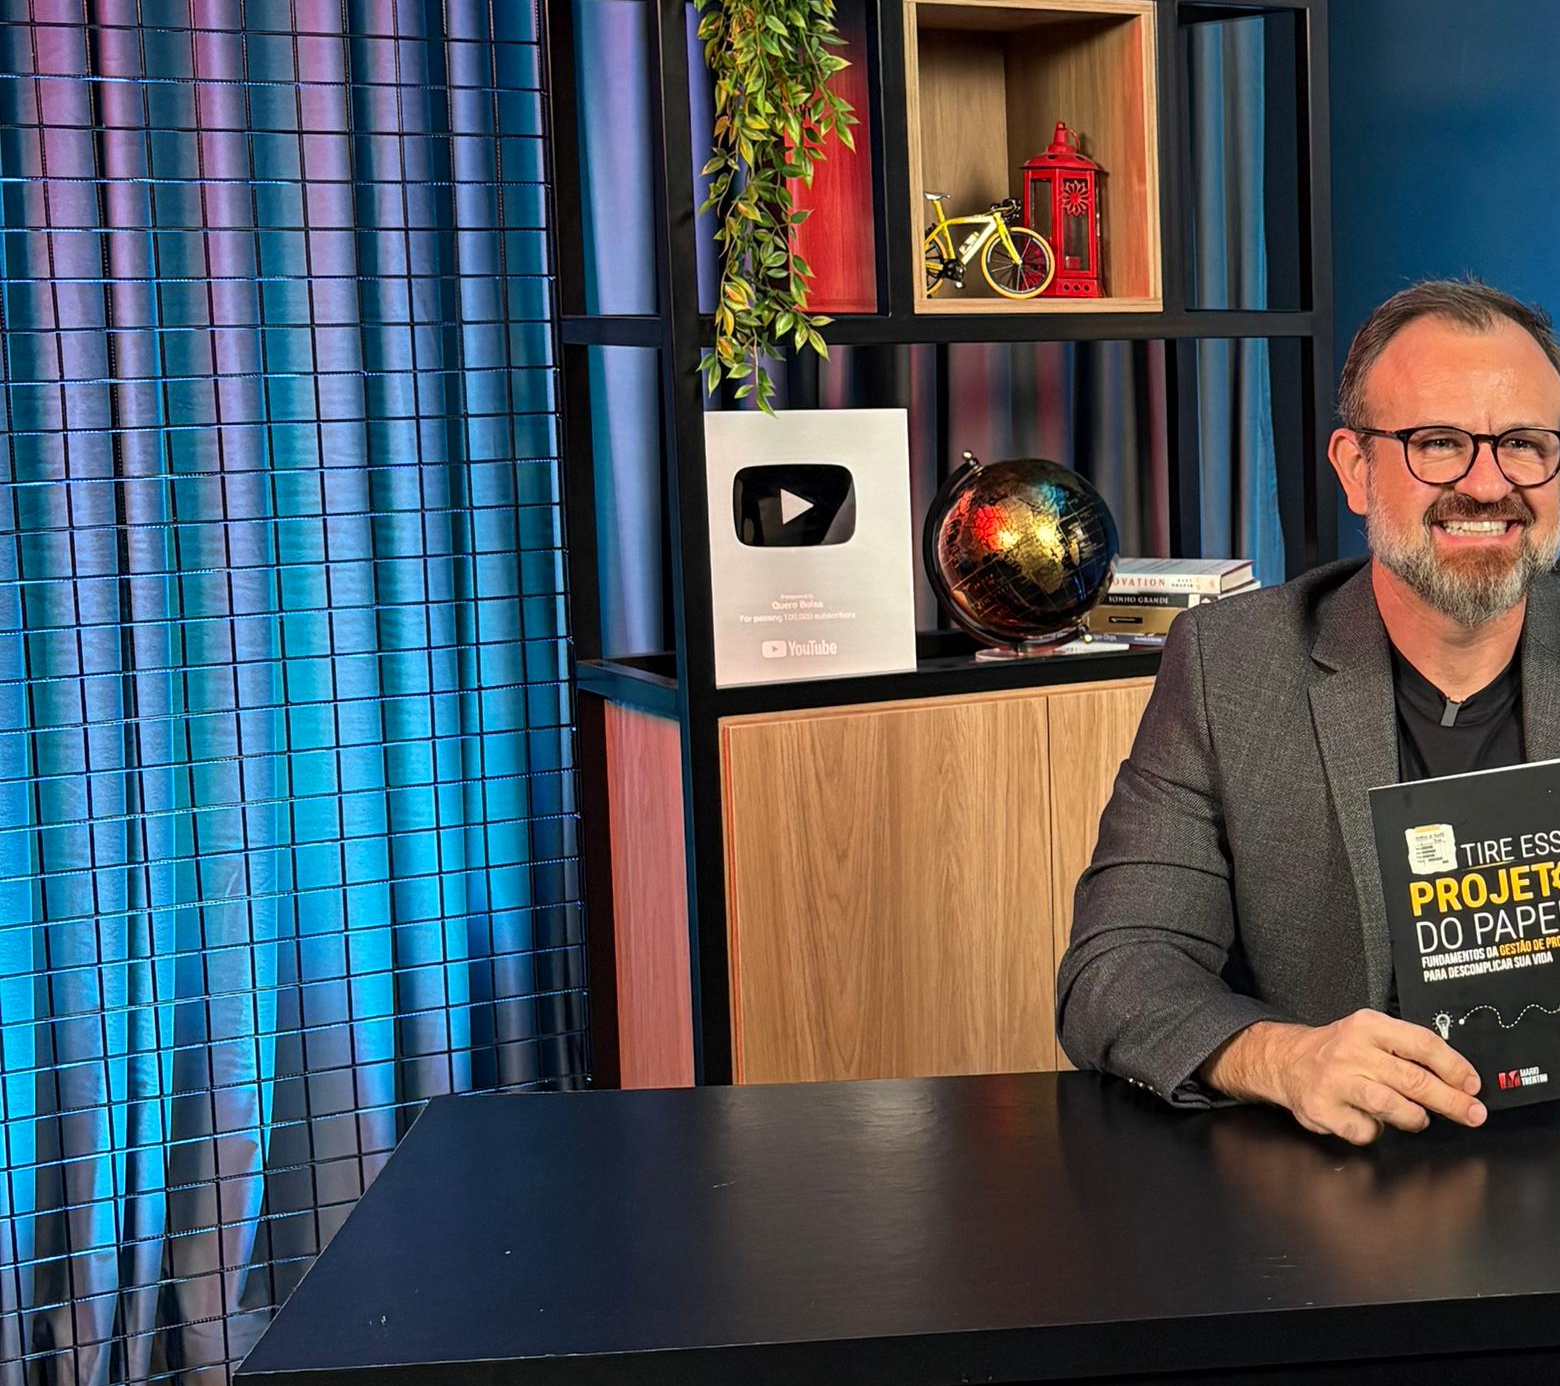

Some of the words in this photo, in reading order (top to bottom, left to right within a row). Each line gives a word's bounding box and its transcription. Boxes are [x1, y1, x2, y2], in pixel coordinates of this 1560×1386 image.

[788, 638, 838, 657] YouTube
[1460, 837, 1515, 866] TIRE
[1416, 917, 1463, 954] DO
[1421, 948, 1485, 968] FUNDAMENTOS
[1486, 946, 1500, 959] DA
[1500, 939, 1532, 956] GESTÃO
[1533, 938, 1545, 951] DE
[1423, 967, 1447, 982] PARA
[1448, 958, 1513, 979] DESCOMPLICAR
[1514, 955, 1532, 968] SUA
[1533, 951, 1553, 965] VIDA
